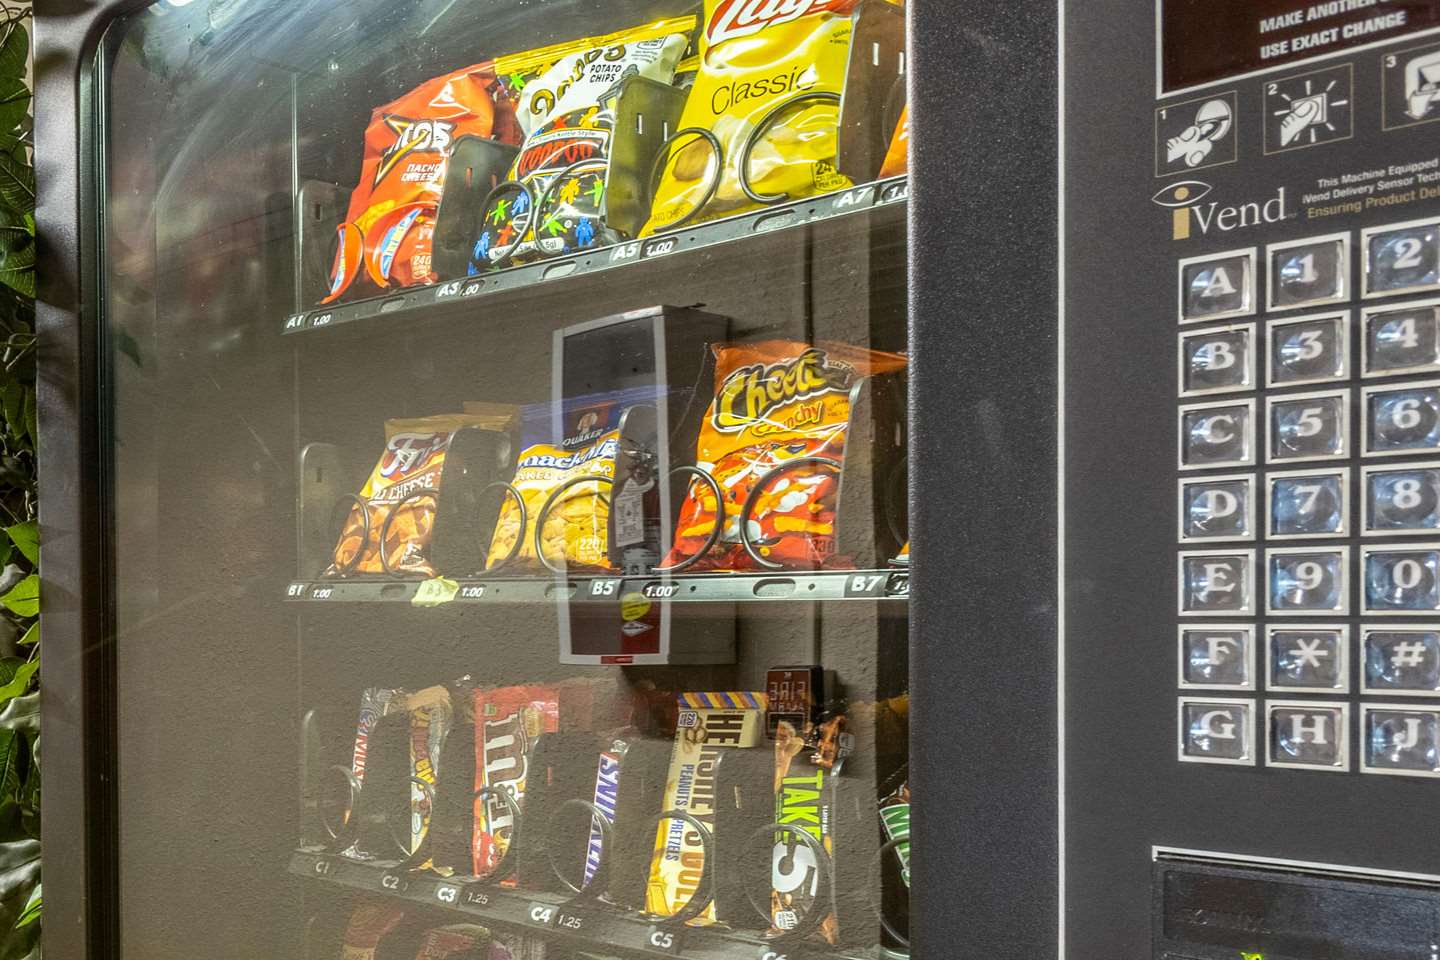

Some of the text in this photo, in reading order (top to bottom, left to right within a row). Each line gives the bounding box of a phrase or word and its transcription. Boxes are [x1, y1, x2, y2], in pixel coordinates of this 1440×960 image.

[1260, 10, 1304, 33] MAKE
[1260, 11, 1406, 59] USE EXACT CHANGE
[590, 64, 622, 74] POTATO
[1385, 55, 1397, 68] 3
[590, 73, 616, 83] CHIPS
[711, 66, 817, 115] Classic
[1267, 83, 1278, 95] 2
[1160, 109, 1168, 120] 1
[1318, 158, 1439, 188] This Machine Equipped
[837, 189, 867, 208] A7
[1333, 184, 1375, 200] Delivery
[1377, 178, 1414, 191] Sensor
[1307, 200, 1362, 218] Ensuring
[1365, 191, 1416, 208] Product
[612, 240, 674, 261] A5 1.00
[1393, 238, 1422, 269] 2
[1200, 266, 1237, 297] A
[1298, 254, 1318, 283] 1
[438, 281, 458, 297] A3
[286, 314, 332, 329] A1 1.00
[1397, 318, 1419, 348] 4
[1207, 342, 1235, 370] B
[1297, 330, 1323, 360] 3
[1297, 407, 1323, 437] 5
[1392, 398, 1420, 429] 6
[562, 428, 603, 447] QUAKER
[1206, 415, 1234, 444] C
[1205, 489, 1237, 518] D
[1294, 485, 1322, 515] 7
[1393, 479, 1422, 509] 8
[591, 581, 674, 597] B5 1.00
[851, 575, 882, 592] B7
[1204, 562, 1236, 592] E
[1295, 562, 1323, 590] 9
[312, 588, 332, 599] 1.00
[461, 586, 484, 598] 1.00
[1205, 637, 1237, 665] F
[1200, 710, 1236, 739] G
[1289, 714, 1327, 744] H
[1392, 717, 1422, 749] J
[665, 763, 695, 862] PEANUTS PRETZELS
[771, 769, 824, 898] TAKE 5
[315, 861, 330, 875] C1
[382, 875, 400, 889] C2
[437, 887, 489, 905] C3 1.25
[530, 906, 582, 930] C4 1.25
[650, 931, 675, 949] C5
